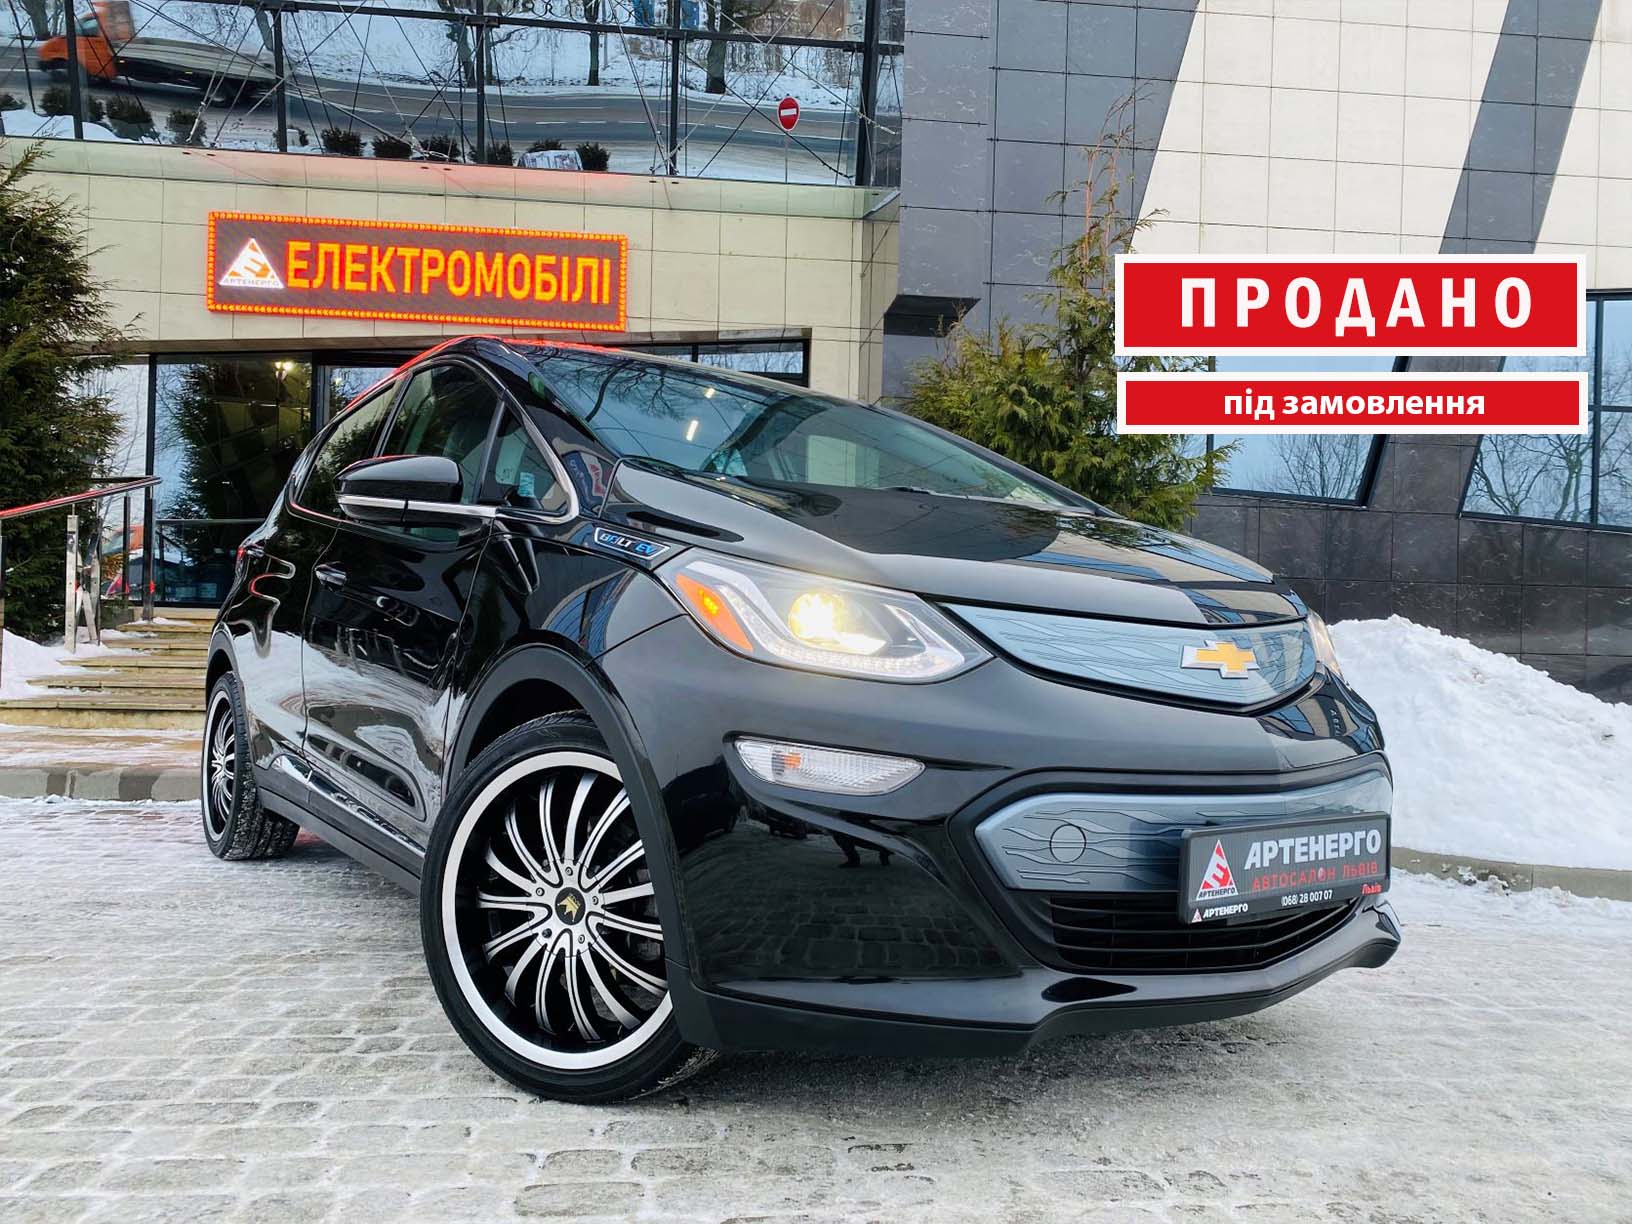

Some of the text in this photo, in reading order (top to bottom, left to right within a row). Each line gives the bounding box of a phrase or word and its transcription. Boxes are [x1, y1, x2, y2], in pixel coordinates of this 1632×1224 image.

[286, 240, 611, 304] ЕЛЕКТРОМОБІЛІ
[635, 543, 656, 554] EV
[1244, 829, 1382, 870] АРТЕНЕРГО
[1199, 886, 1236, 898] АРТЕНЕРГО
[1281, 896, 1298, 907] (068)
[1299, 894, 1309, 902] 28
[1203, 903, 1249, 919] АРТЕНЕРГО
